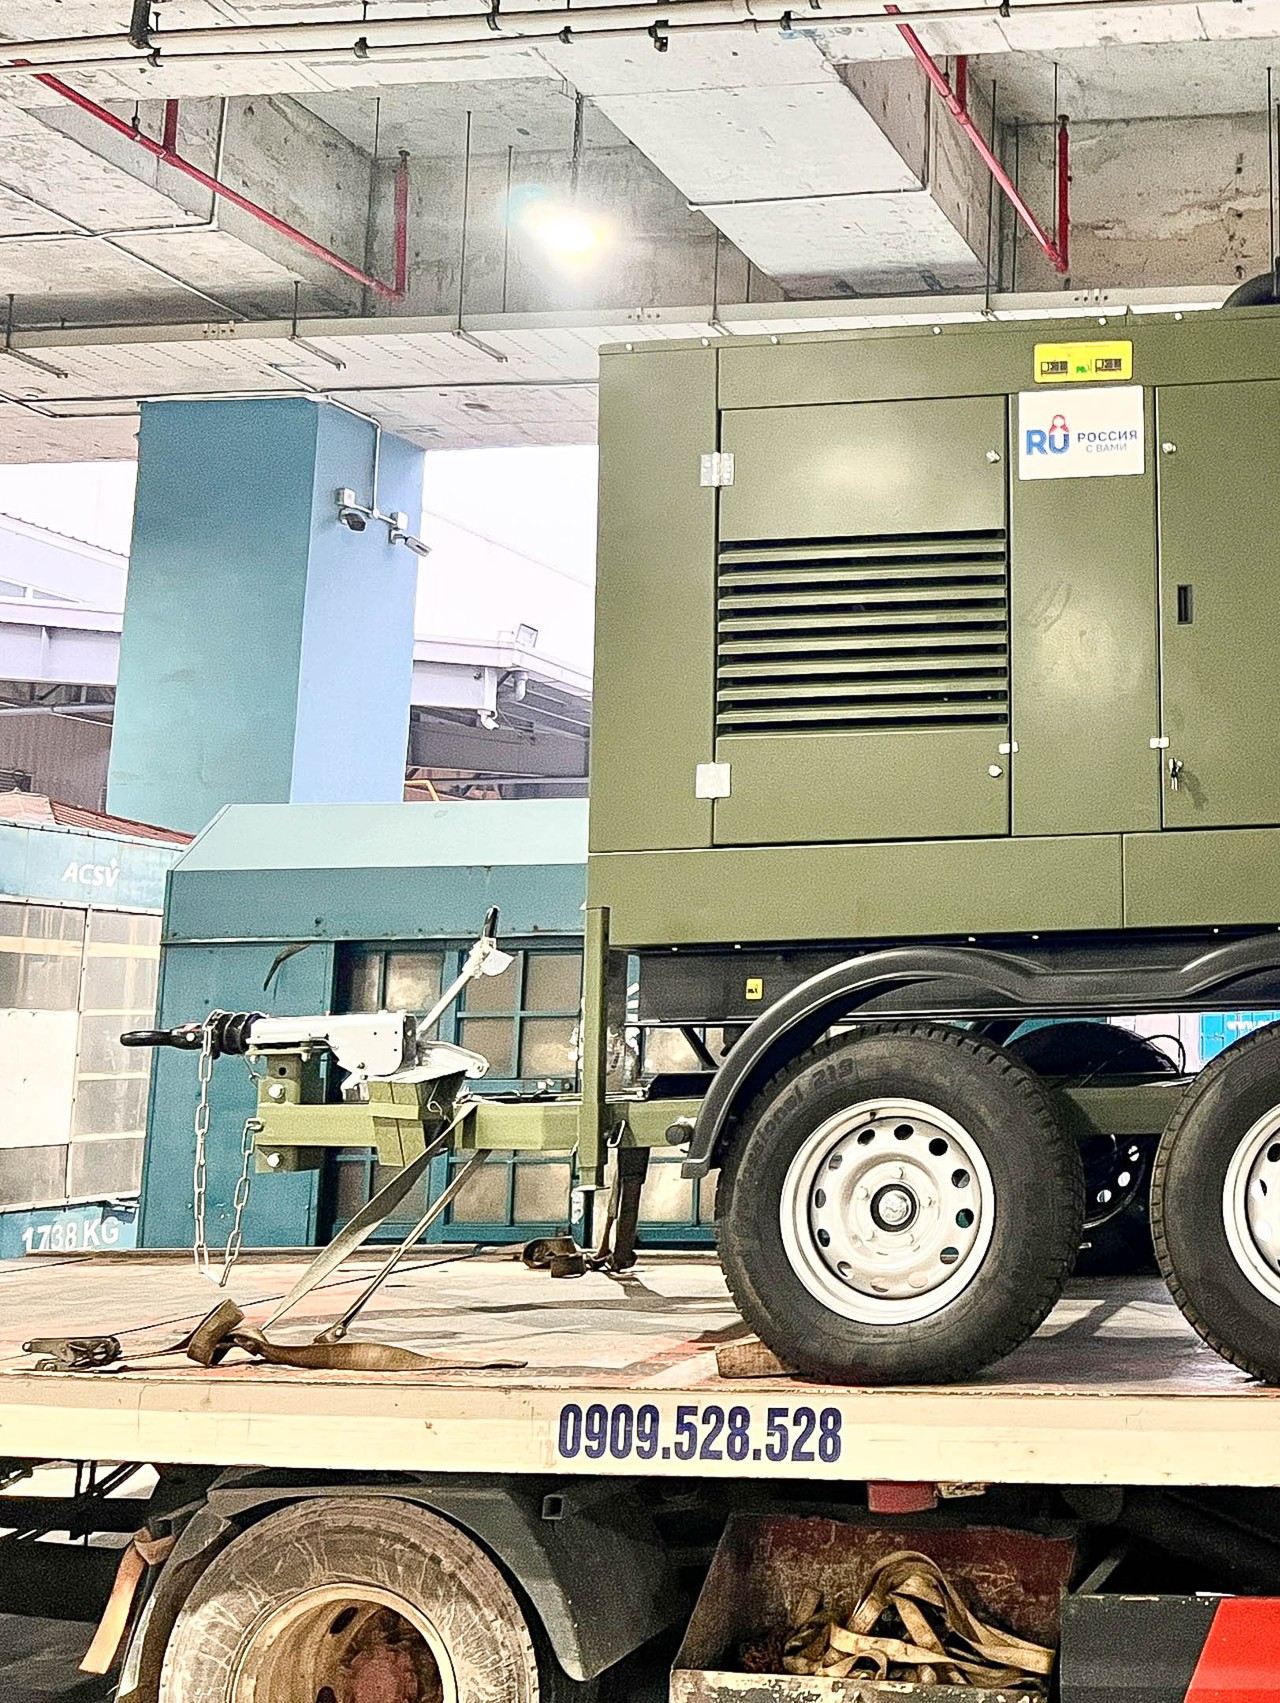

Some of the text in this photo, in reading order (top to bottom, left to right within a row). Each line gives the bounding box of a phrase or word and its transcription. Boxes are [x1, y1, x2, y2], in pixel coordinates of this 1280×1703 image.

[1026, 429, 1070, 455] RU
[1077, 429, 1138, 442] РОССИЯ
[1096, 443, 1127, 453] ВАМИ
[61, 860, 121, 888] ACSV
[21, 1216, 120, 1250] 1738 KG
[558, 1403, 842, 1463] 0909.528.528
